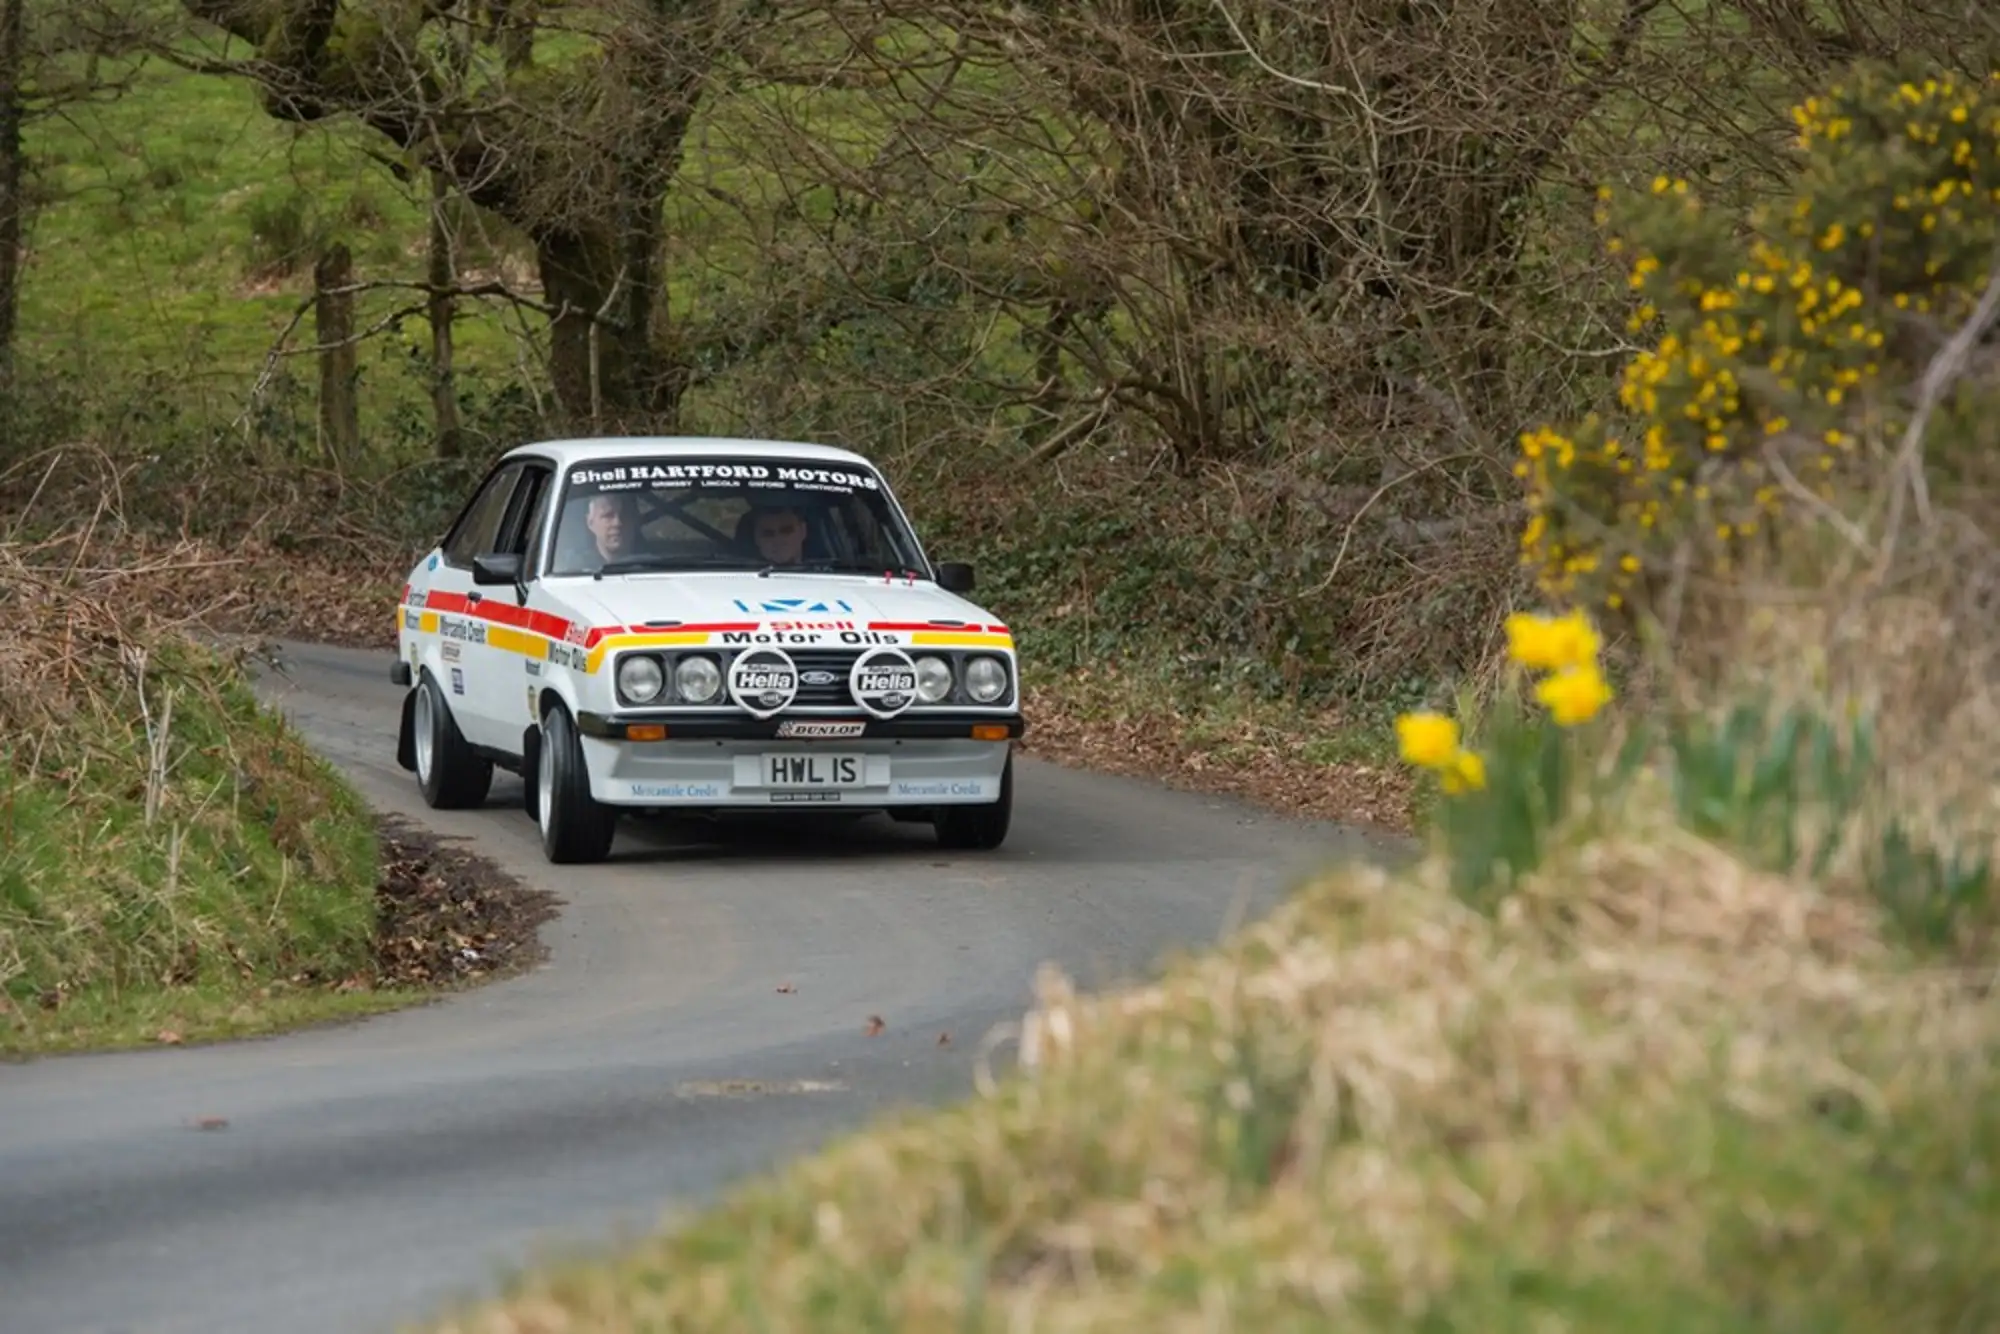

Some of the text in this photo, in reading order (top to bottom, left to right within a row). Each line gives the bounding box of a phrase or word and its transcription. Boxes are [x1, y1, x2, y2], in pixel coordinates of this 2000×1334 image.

[571, 465, 879, 490] Shell HARTFORD MOTORS
[769, 621, 855, 631] Shell
[721, 631, 899, 645] Motor Oils
[739, 672, 791, 688] Hella
[861, 673, 912, 689] Hella
[794, 725, 862, 735] DUNLOP
[771, 757, 825, 783] HWL
[631, 784, 718, 797] Mercantile Credit
[898, 782, 982, 796] Mercantile Credit
